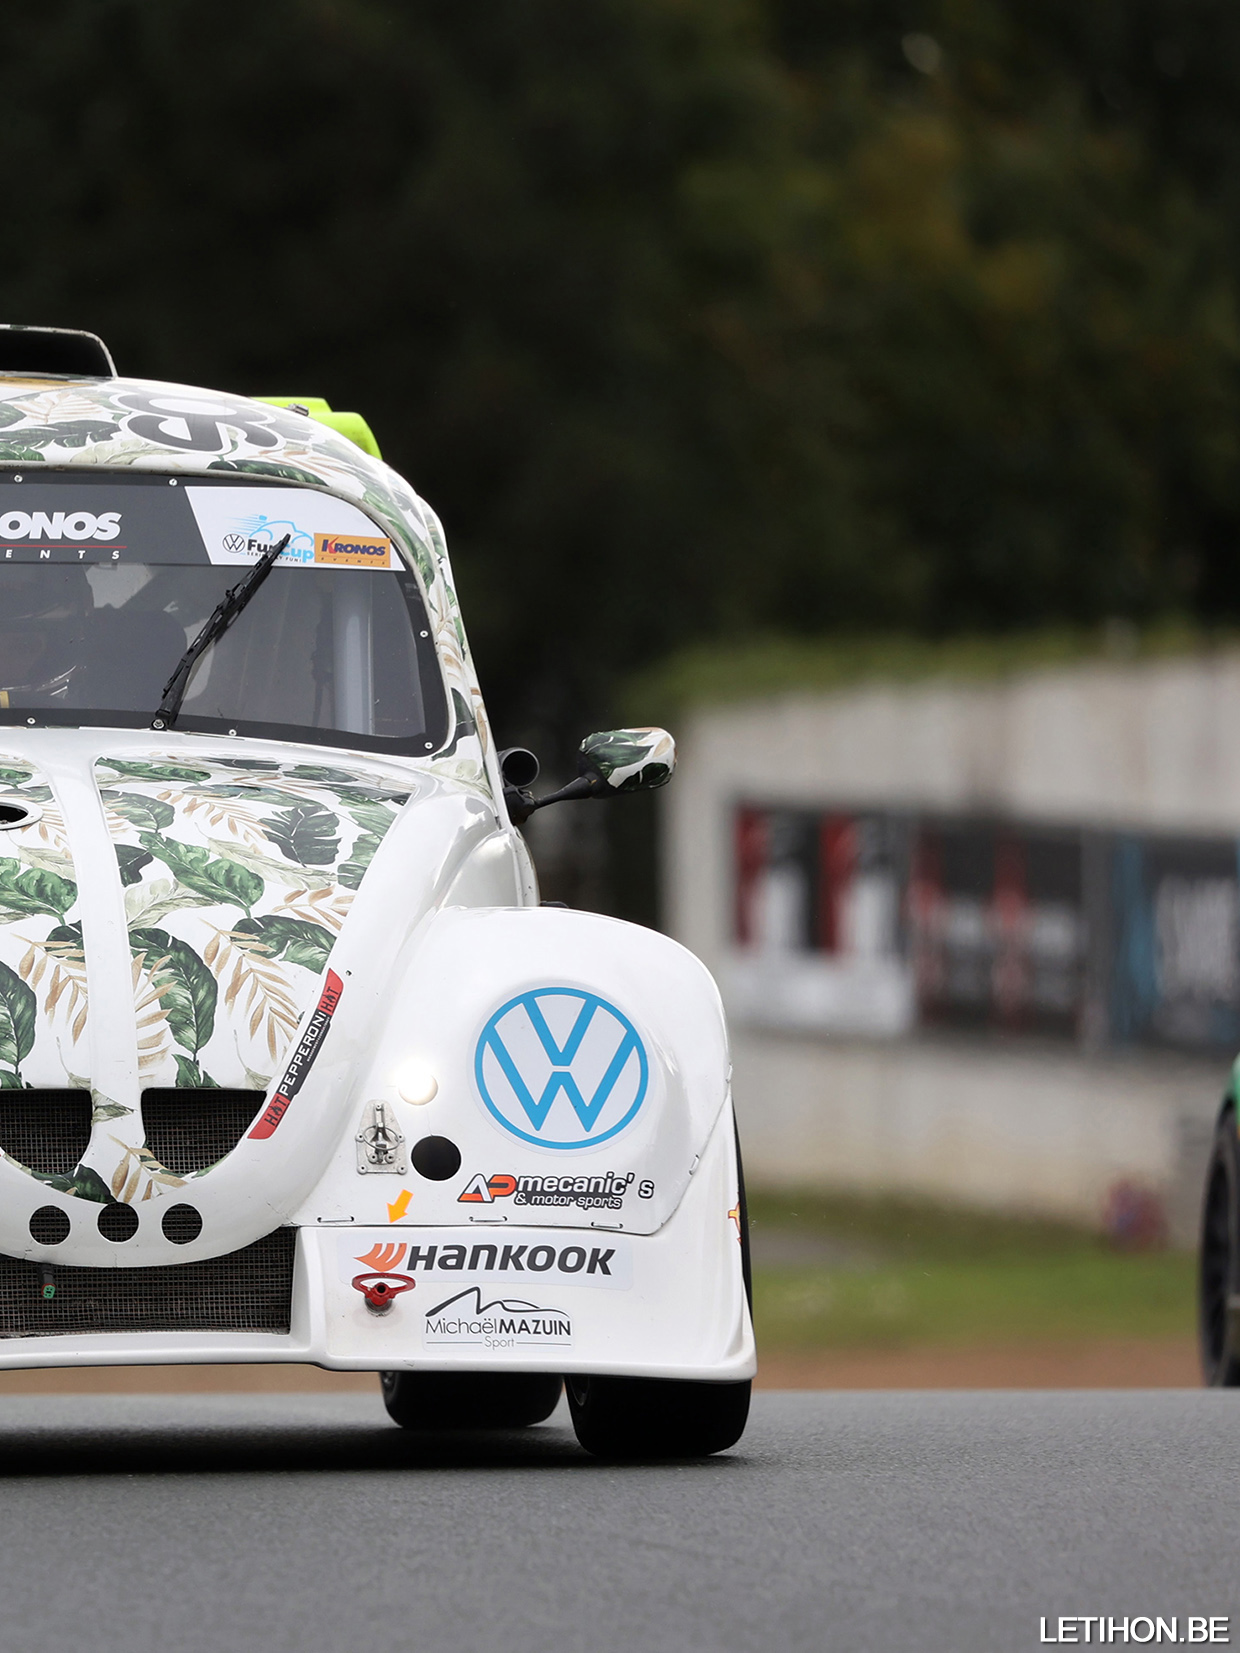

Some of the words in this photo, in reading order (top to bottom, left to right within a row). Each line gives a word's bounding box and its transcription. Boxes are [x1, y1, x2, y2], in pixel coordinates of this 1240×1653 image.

[321, 536, 386, 556] KRONOS
[278, 1011, 327, 1096] PEPPERONI
[531, 1194, 575, 1206] motor
[577, 1195, 623, 1210] sports
[484, 1335, 515, 1350] Sport
